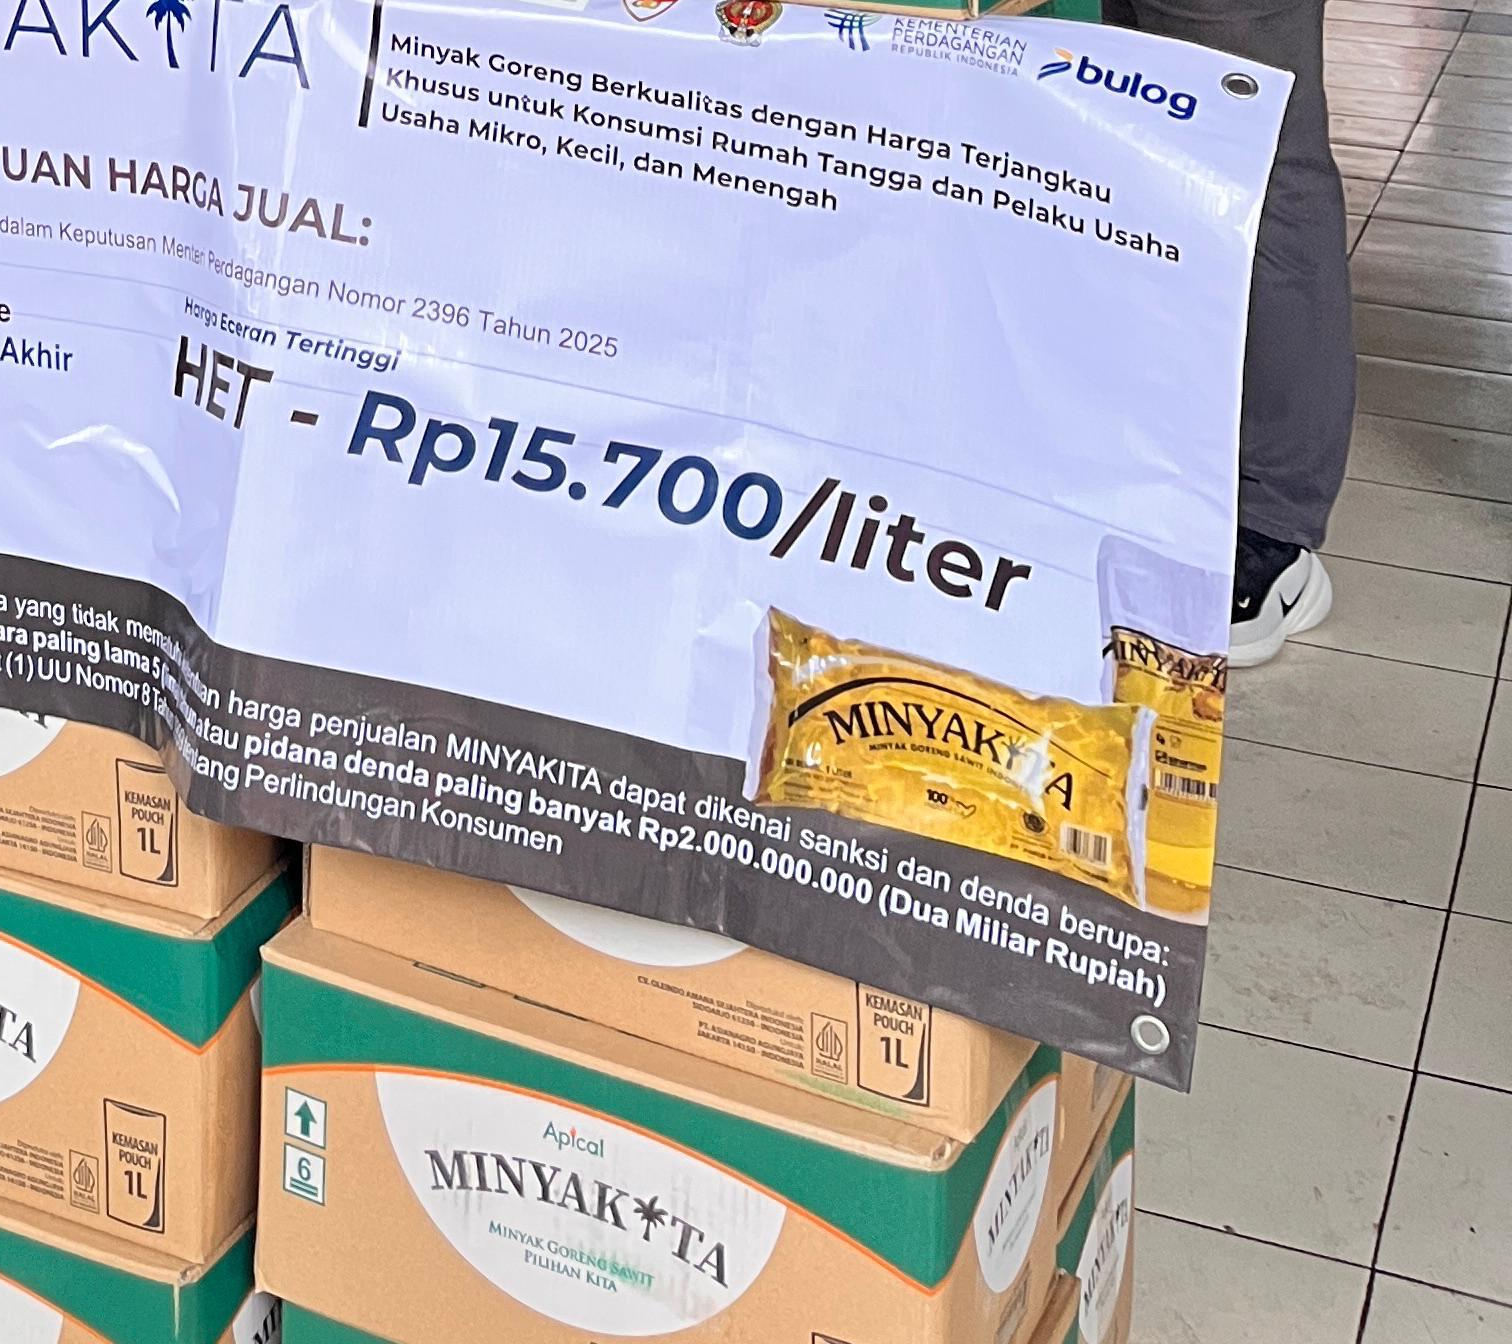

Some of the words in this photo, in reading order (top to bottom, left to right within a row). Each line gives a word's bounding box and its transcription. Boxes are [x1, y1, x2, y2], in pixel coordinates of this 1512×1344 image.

[390, 32, 480, 68] Minyak
[488, 52, 582, 91] Goreng
[591, 73, 743, 120] Berkualitas
[750, 104, 857, 140] dengan
[867, 124, 950, 160] Harga
[961, 142, 1113, 204] Terjangkau
[1075, 55, 1198, 121] bulog
[108, 156, 224, 217] HARGA
[233, 183, 373, 248] JUAL:
[381, 102, 460, 135] Usaha
[469, 118, 548, 156] Mikro,
[556, 137, 625, 171] Kecil,
[633, 151, 684, 180] dan
[692, 163, 837, 212] Menengah
[387, 66, 480, 103] Khusus
[487, 88, 564, 120] untuk
[573, 103, 703, 148] Konsumsi
[712, 131, 808, 169] Rumah
[817, 151, 922, 191] Tangga
[932, 175, 983, 206] dan
[993, 192, 1084, 234] Pelaku
[1093, 218, 1180, 262] Usaha
[58, 221, 157, 253] Keputusan
[328, 279, 406, 314] Nomor
[412, 297, 470, 328] 2396
[478, 309, 551, 345] Tahun
[558, 327, 619, 358] 2025
[184, 296, 219, 329] Harga
[220, 312, 277, 347] Eceran
[285, 330, 402, 373] Tertinggi
[0, 336, 74, 372] Akhir
[173, 334, 274, 430] HET
[346, 389, 1032, 611] Rp15.700/liter
[14, 596, 65, 626] yang
[72, 603, 120, 633] tidak
[228, 689, 303, 730] harga
[309, 711, 438, 756] penjualan
[446, 734, 603, 795] MINYAKITA
[609, 775, 687, 817] dapat
[695, 792, 793, 845] dikenai
[799, 828, 889, 875] sanksi
[897, 855, 952, 893] dan
[960, 875, 1050, 927] denda
[1059, 899, 1170, 967] berupa:
[32, 629, 101, 663] paling
[105, 639, 151, 674] lama
[244, 731, 338, 771] pidana
[343, 748, 431, 787] denda
[435, 769, 523, 814] paling
[528, 790, 631, 838] banyak
[638, 815, 873, 907] Rp2.000.000.000
[879, 883, 950, 931] (Dua
[955, 909, 1041, 959] Miliar
[1045, 938, 1168, 1008] Rupiah)
[123, 788, 172, 813] KEMASAN
[131, 806, 165, 828] POUCH
[244, 762, 416, 822] Perlindungan
[421, 803, 564, 856] Konsumen
[136, 827, 162, 856] 1L
[542, 1119, 605, 1160] Apical
